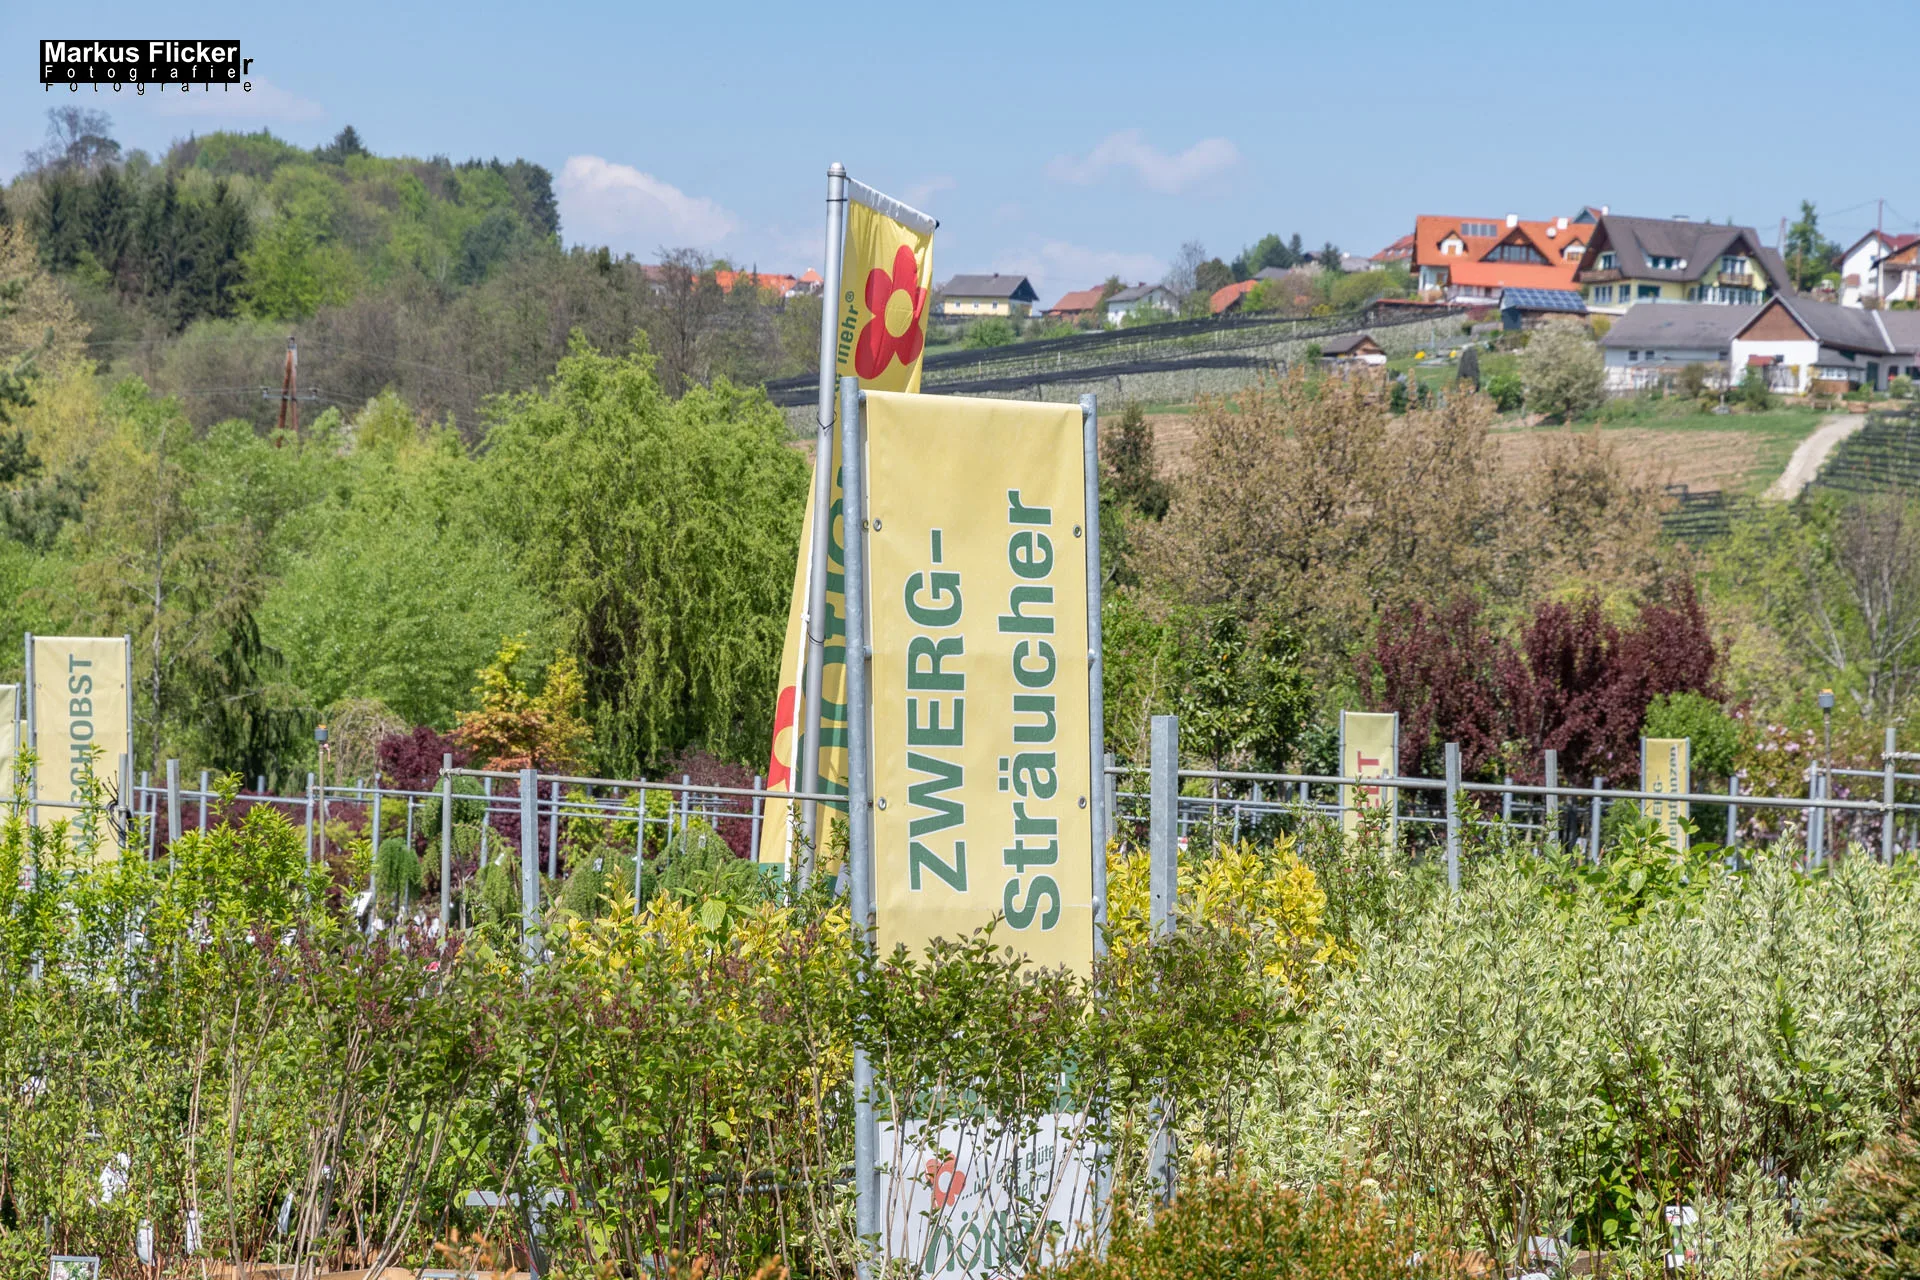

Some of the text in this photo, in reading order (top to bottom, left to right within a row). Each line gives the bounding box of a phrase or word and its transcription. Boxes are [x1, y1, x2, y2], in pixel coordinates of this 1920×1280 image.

[904, 528, 968, 893] ZWERG-
[997, 488, 1062, 932] Sträucher
[1025, 1144, 1055, 1171] Büte
